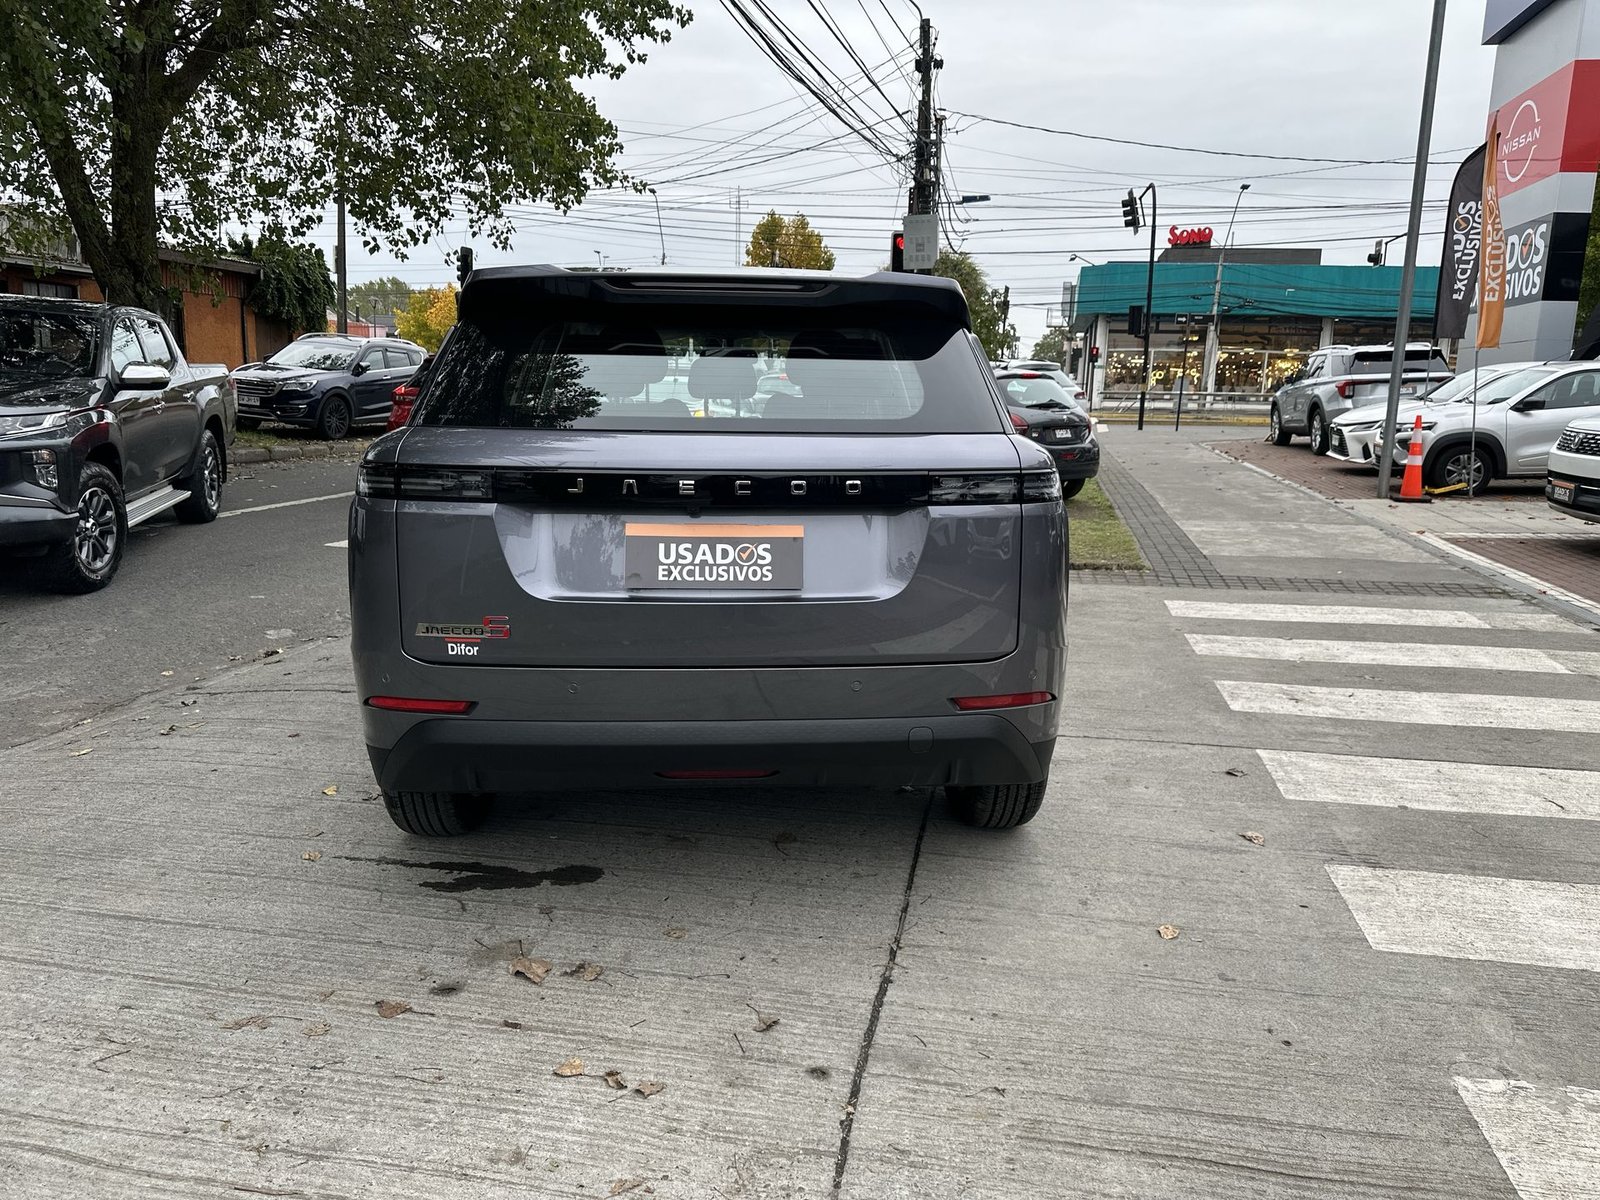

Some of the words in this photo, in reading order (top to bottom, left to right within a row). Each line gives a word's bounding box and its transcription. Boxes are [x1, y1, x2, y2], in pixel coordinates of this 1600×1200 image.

[1502, 126, 1541, 156] NISSAN
[1167, 225, 1213, 245] SONO
[1506, 223, 1547, 271] DOS
[568, 478, 862, 495] JAECOO
[658, 543, 772, 565] USADOS
[658, 565, 773, 582] EXCLUSIVOS
[421, 626, 485, 636] JAECOO
[447, 643, 479, 656] Difor
